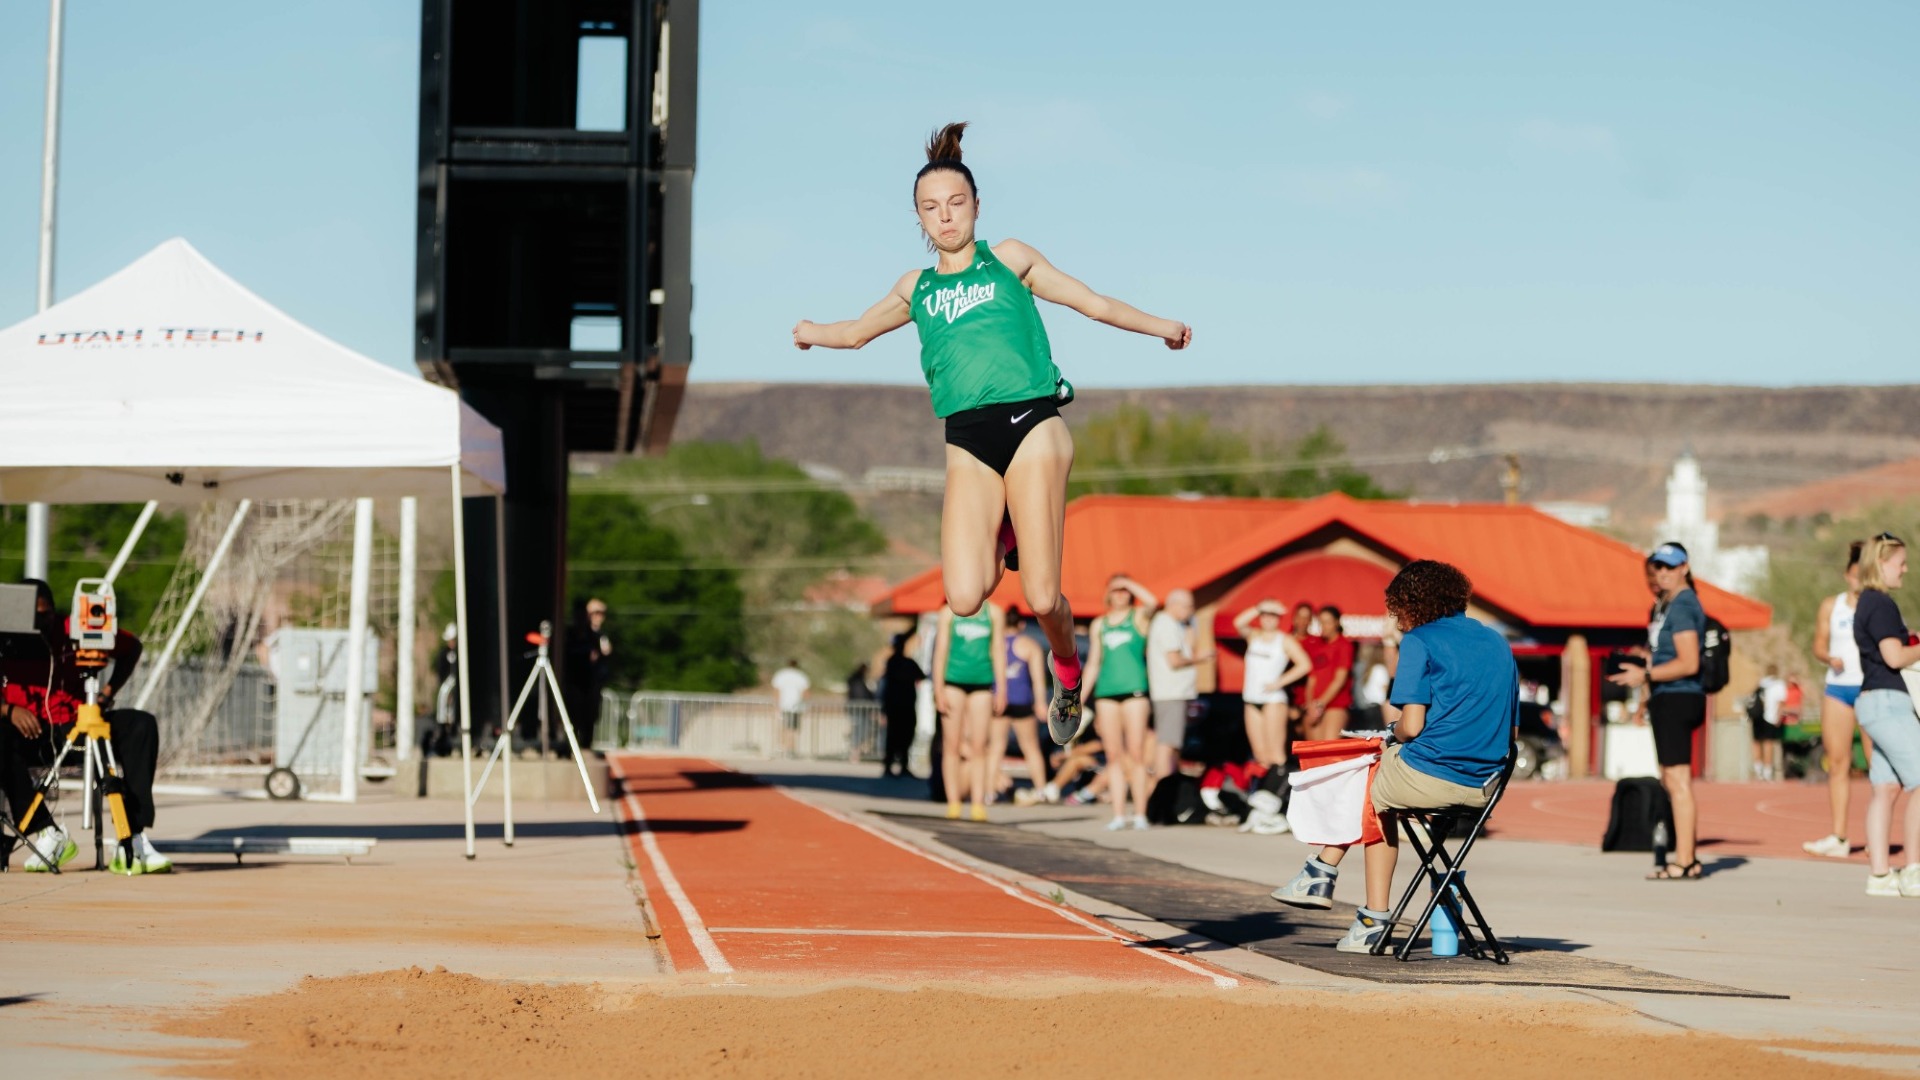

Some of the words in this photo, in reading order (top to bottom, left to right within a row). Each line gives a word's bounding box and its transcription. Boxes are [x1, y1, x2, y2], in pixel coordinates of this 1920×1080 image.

[922, 281, 967, 317] Utah
[940, 282, 996, 324] Valley
[37, 329, 143, 345] UTAH
[158, 327, 263, 342] TECH
